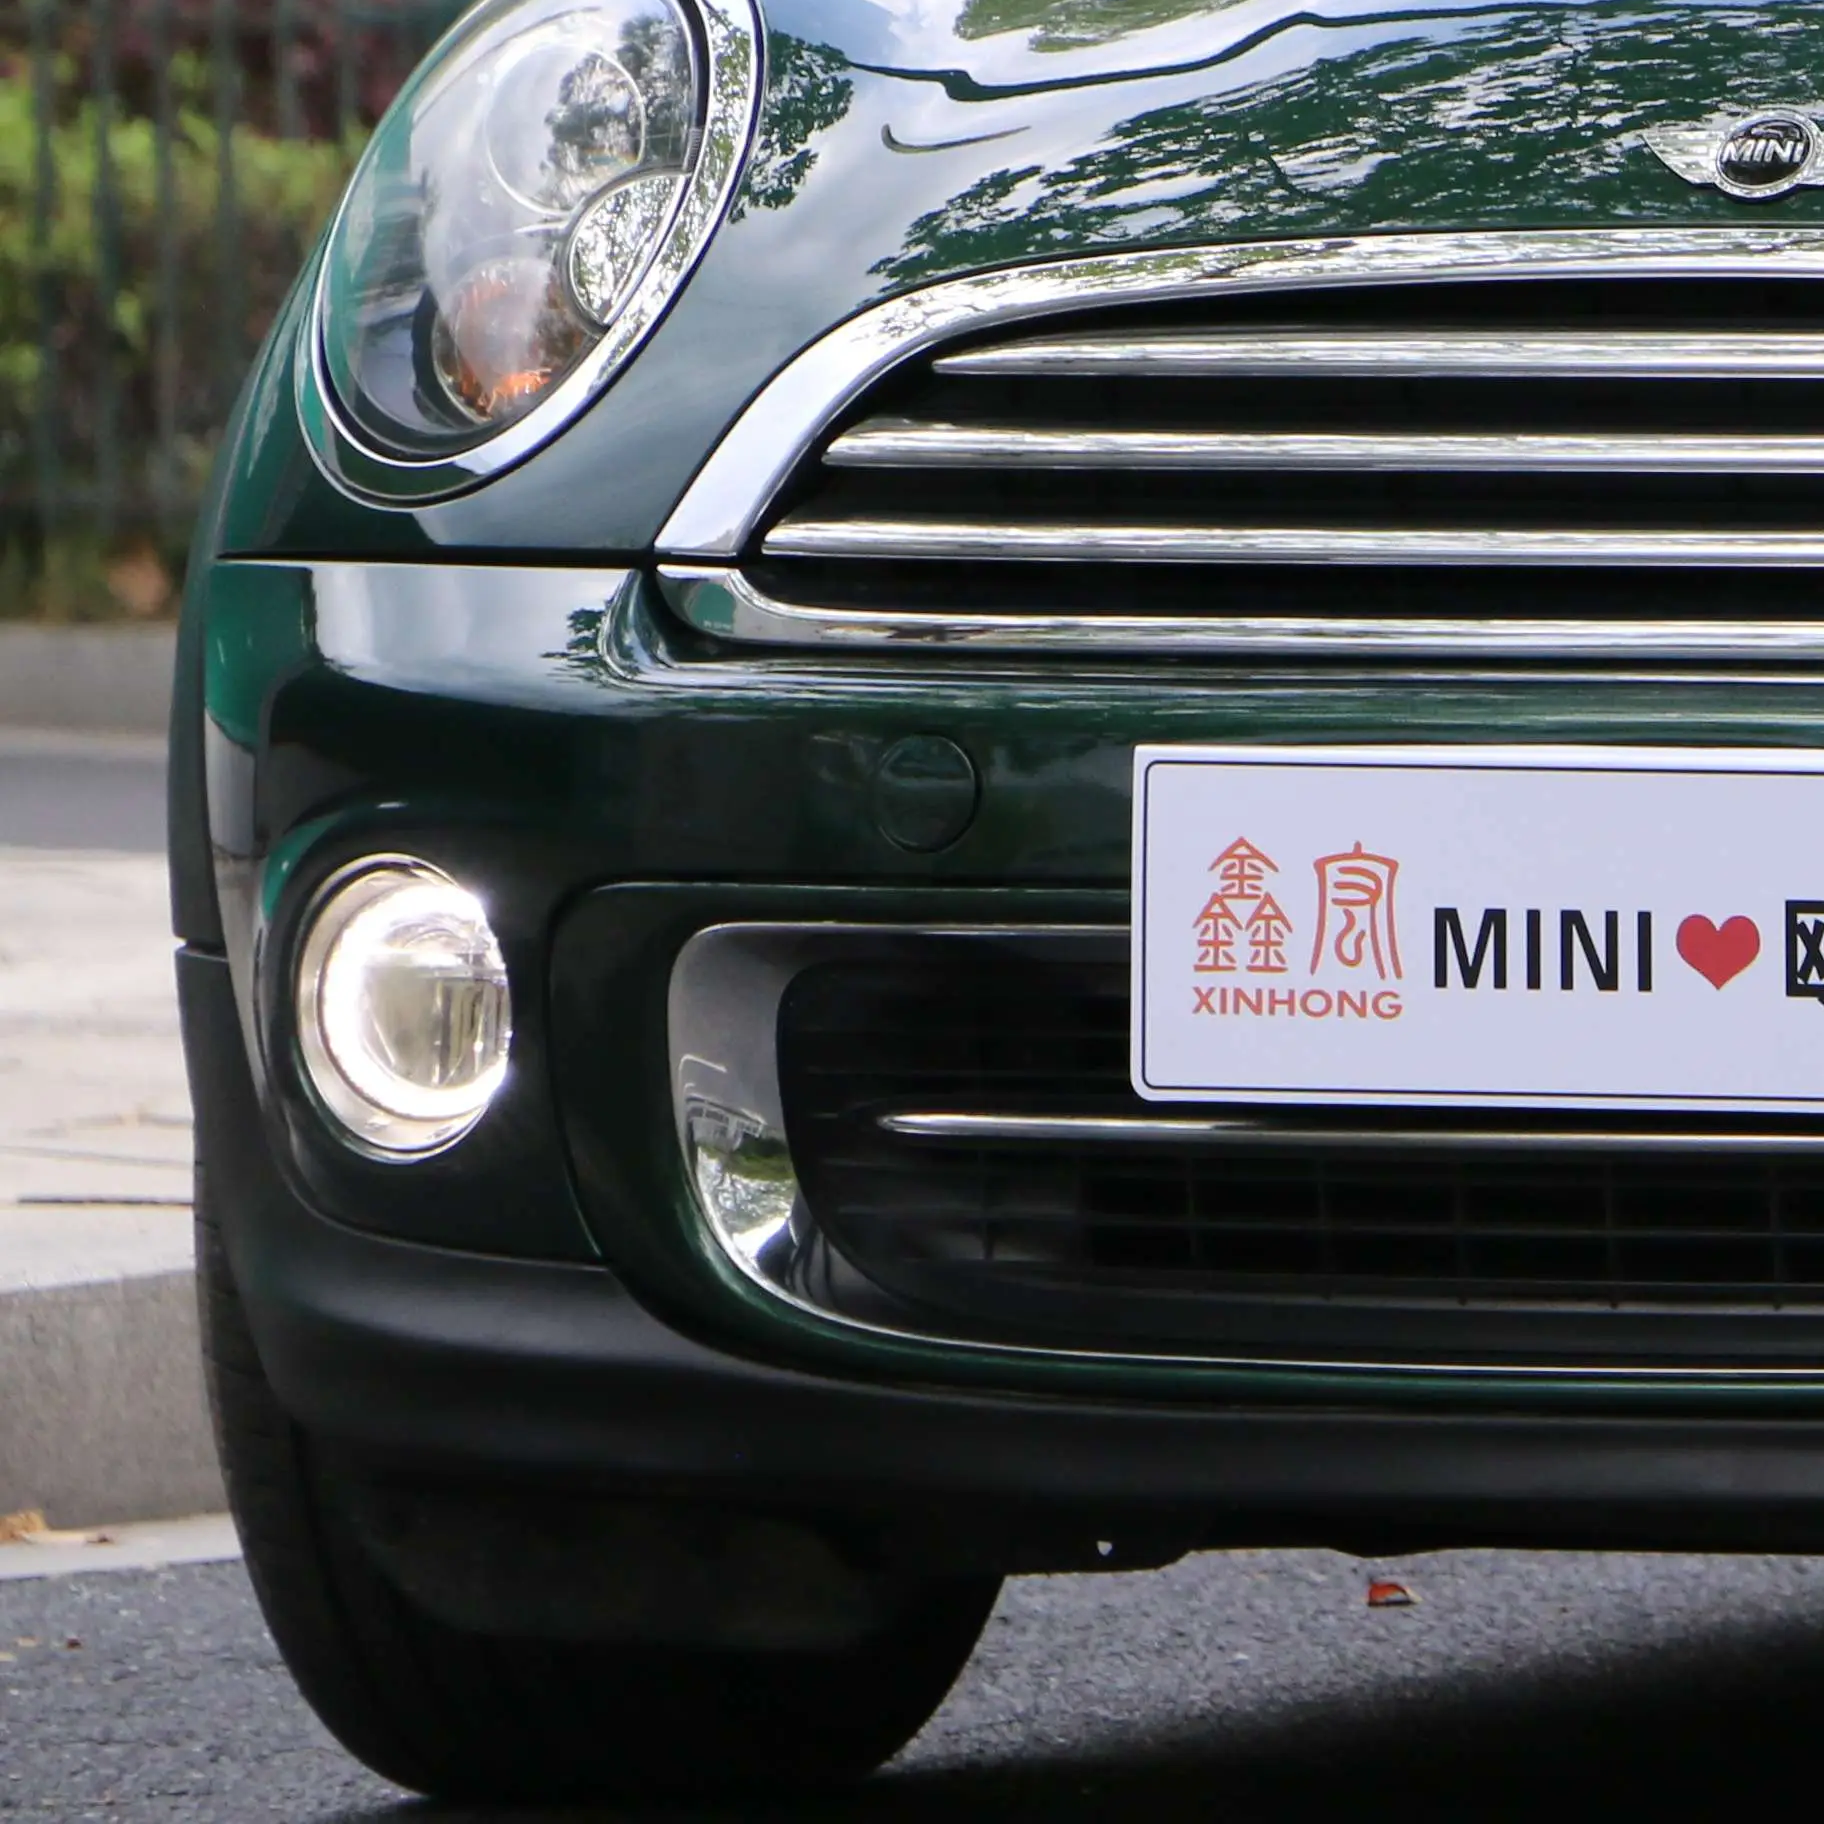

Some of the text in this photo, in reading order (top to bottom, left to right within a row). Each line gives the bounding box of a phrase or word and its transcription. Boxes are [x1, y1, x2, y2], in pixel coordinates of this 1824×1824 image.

[1721, 137, 1803, 163] MINI
[1433, 907, 1653, 993] MINI
[1192, 986, 1403, 1020] XINHONG
